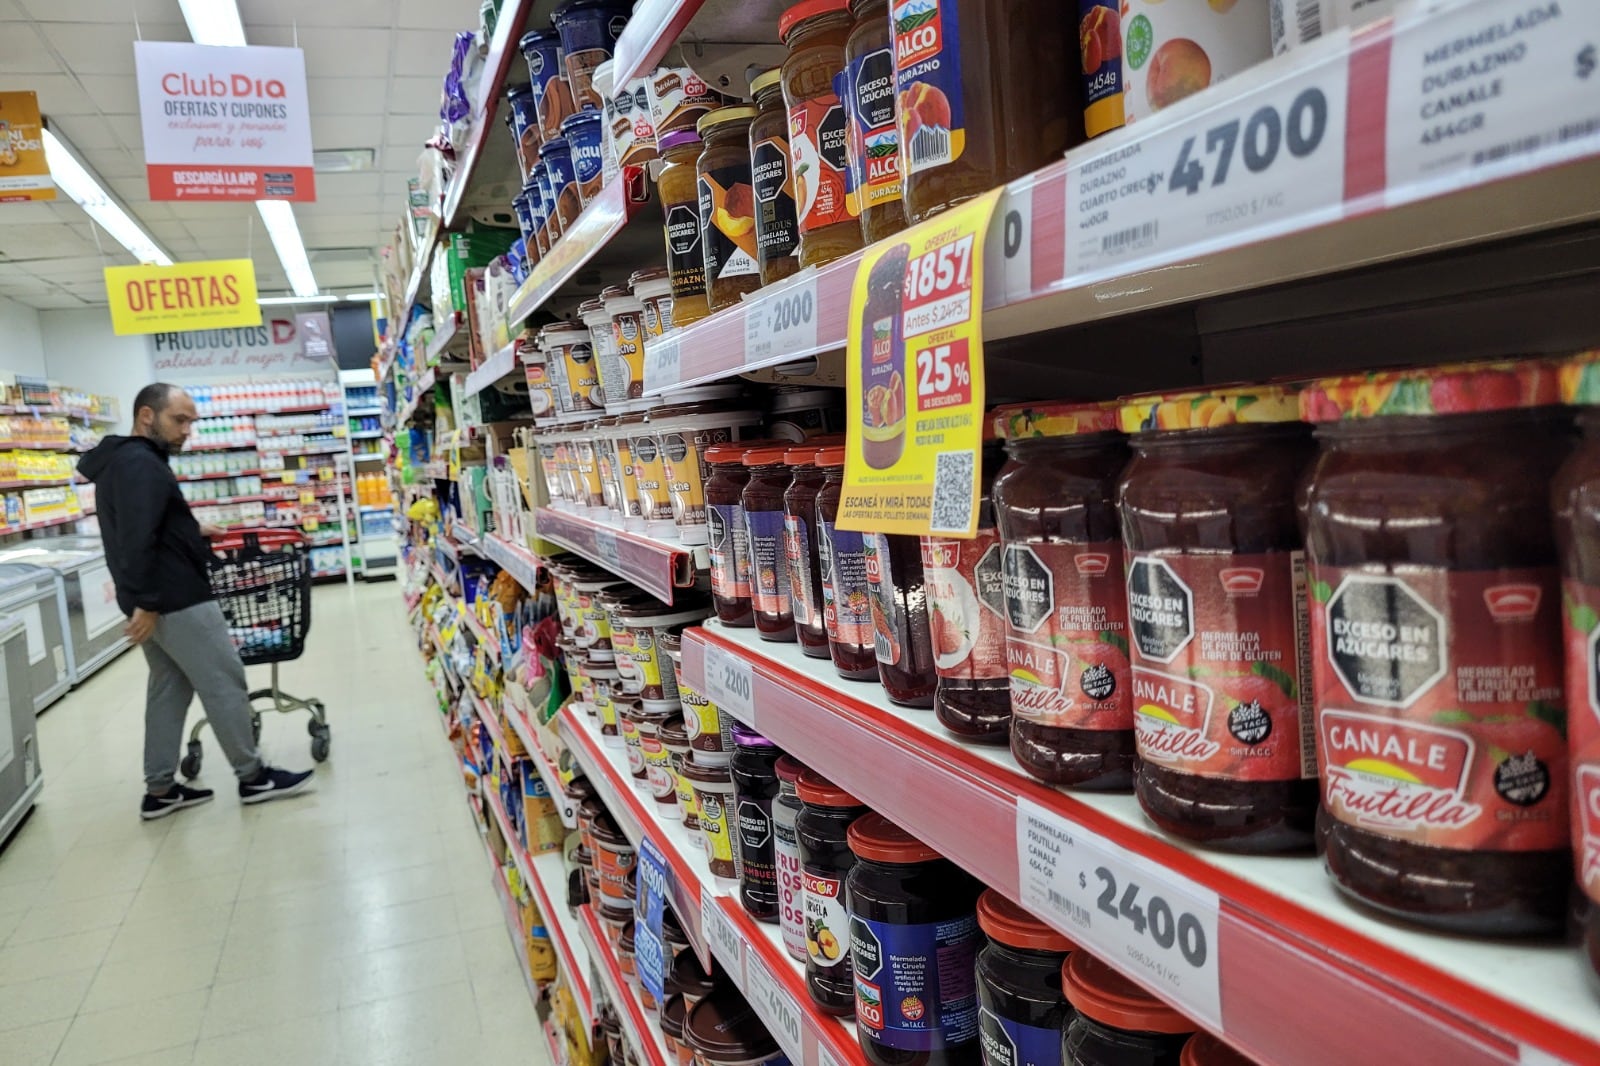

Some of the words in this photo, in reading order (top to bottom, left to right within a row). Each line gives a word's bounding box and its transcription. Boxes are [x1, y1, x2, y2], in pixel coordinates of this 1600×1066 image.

[898, 26, 937, 60] ALCO
[1423, 2, 1561, 67] MERMELADA
[899, 59, 940, 85] DURAZNO
[1422, 42, 1527, 94] DURAZNO
[859, 77, 888, 95] EXCESO
[1093, 71, 1116, 90] 454g
[164, 100, 218, 117] OFERTAS
[221, 102, 229, 117] Y
[231, 102, 287, 119] CUPONES
[1420, 79, 1502, 120] CANALE
[821, 128, 846, 141] EXCE
[1168, 87, 1327, 196] 4700
[773, 158, 782, 169] EN
[1079, 143, 1142, 177] MERMELADA
[1079, 167, 1126, 195] DURAZNO
[1079, 189, 1119, 213] CUARTO
[687, 221, 696, 229] EN
[126, 274, 241, 313] OFERTAS
[774, 290, 813, 333] 2000
[905, 312, 931, 331] Antes
[155, 325, 269, 351] PRODUCTOS
[873, 340, 891, 357] ALCO
[917, 345, 952, 396] 25
[954, 361, 970, 388] %
[845, 494, 878, 508] ESCANEÁ
[906, 496, 932, 508] TODAS
[1031, 578, 1045, 591] EN
[1131, 592, 1162, 608] EXCESO
[1164, 598, 1183, 611] EN
[1132, 607, 1184, 627] AZÚCARES
[1201, 631, 1260, 642] MERMELADA
[1334, 619, 1396, 643] EXCESO
[1401, 626, 1430, 643] EN
[1215, 641, 1260, 651] FRUTILLA
[1231, 651, 1242, 661] DE
[1244, 650, 1282, 662] GLUTEN
[1336, 639, 1429, 662] AZÚCARES
[725, 665, 749, 702] 2200
[1456, 665, 1536, 680] MERMELADA
[1132, 679, 1195, 715] CANALE
[1329, 726, 1447, 771] CANALE
[1327, 768, 1482, 824] Frutilla
[1027, 830, 1061, 857] FRUTILLA
[1028, 816, 1074, 848] MERMELADA
[1027, 844, 1057, 868] CANALE
[1029, 857, 1042, 873] 454
[1079, 871, 1087, 890] $
[1095, 866, 1207, 968] 2400
[867, 942, 877, 953] EN
[902, 962, 926, 970] Ciruela
[857, 1003, 881, 1024] ALCO
[999, 1043, 1011, 1058] EN
